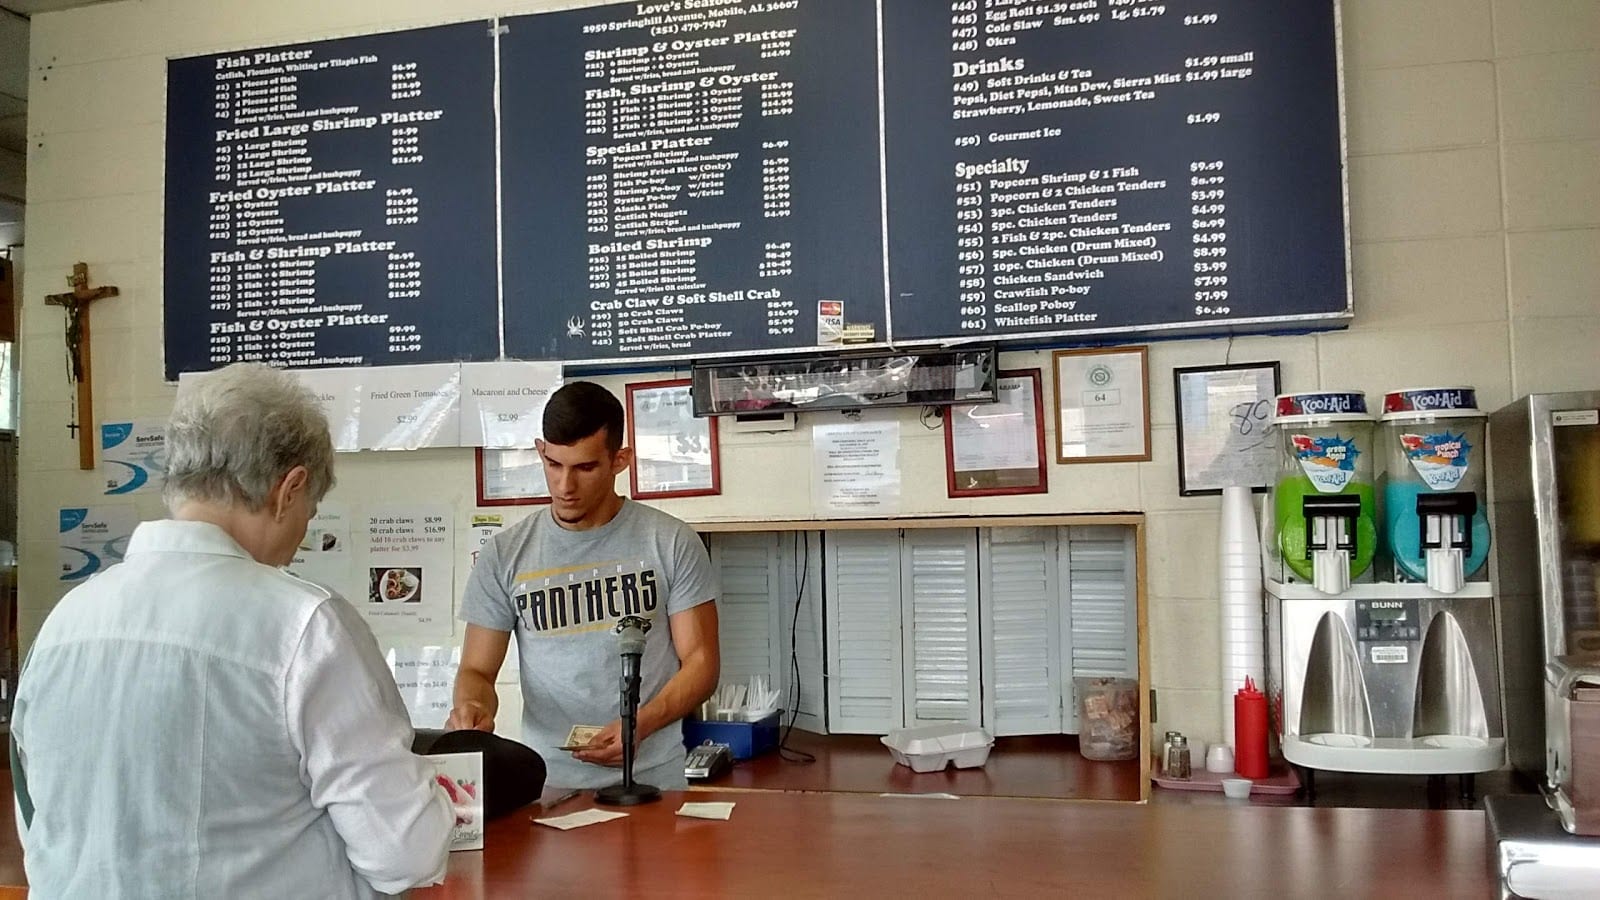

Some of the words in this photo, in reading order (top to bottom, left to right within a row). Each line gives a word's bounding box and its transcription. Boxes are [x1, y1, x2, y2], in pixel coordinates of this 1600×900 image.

[583, 23, 606, 32] 2959
[608, 16, 661, 30] Springhill
[664, 12, 705, 23] Avenue,
[708, 6, 746, 17] Mobile,
[748, 3, 764, 12] AL
[766, 0, 798, 11] 36607
[637, 0, 680, 15] Love's
[952, 13, 976, 24] #45)
[985, 10, 1006, 21] Egg
[1009, 6, 1032, 17] Roll
[1036, 3, 1067, 14] $1.39
[1069, 0, 1096, 10] each
[651, 24, 678, 36] (251)
[681, 19, 726, 31] 479-7947
[952, 26, 976, 37] #47)
[985, 22, 1010, 33] Cole
[1013, 20, 1042, 30] Slaw
[1054, 16, 1076, 25] Sm.
[1112, 9, 1129, 20] Lg.
[1132, 6, 1164, 17] $1.79
[952, 40, 977, 50] #48)
[986, 37, 1015, 46] Okra
[1184, 14, 1217, 25] $1.99
[584, 46, 648, 60] Shrimp
[652, 42, 667, 52] &
[672, 37, 729, 50] Oyster
[734, 29, 796, 43] Platter
[216, 56, 250, 68] Fish
[254, 50, 312, 64] Platter
[952, 58, 1024, 77] Drinks
[953, 80, 978, 91] #49)
[987, 77, 1011, 88] Soft
[1014, 73, 1055, 84] Drinks
[1058, 70, 1068, 79] &
[1071, 69, 1091, 78] Tea
[1185, 56, 1217, 67] $1.59
[1220, 52, 1252, 63] small
[585, 87, 625, 100] Fish,
[630, 81, 694, 94] Shrimp
[699, 76, 714, 86] &
[718, 72, 777, 85] Oyster
[954, 93, 987, 105] Pepsi,
[990, 91, 1014, 101] Diet
[1017, 86, 1051, 98] Pepsi,
[1054, 84, 1077, 94] Mtn
[1080, 82, 1110, 91] Dew,
[1113, 77, 1151, 88] Sierra
[1154, 73, 1180, 84] Mist
[1186, 70, 1218, 81] $1.99
[1220, 68, 1251, 78] large
[953, 105, 1024, 119] Strawberry,
[1027, 96, 1091, 110] Lemonade,
[1094, 92, 1130, 104] Sweet
[1133, 90, 1154, 99] Tea
[216, 127, 258, 141] Fried
[263, 124, 308, 136] Large
[313, 117, 377, 130] Shrimp
[381, 110, 442, 124] Platter
[955, 135, 980, 146] #50)
[988, 129, 1040, 142] Gourmet
[1044, 128, 1060, 136] Ice
[1187, 112, 1219, 123] $1.99
[586, 141, 646, 157] Special
[651, 137, 712, 149] Platter
[955, 158, 1028, 179] Specialty
[956, 181, 981, 192] #51)
[990, 178, 1038, 189] Popcorn
[1041, 173, 1086, 183] Shrimp
[1089, 170, 1099, 179] &
[1103, 170, 1108, 178] 1
[1112, 167, 1138, 177] Fish
[210, 189, 252, 202] Fried
[256, 186, 311, 199] Oyster
[316, 180, 375, 193] Platter
[211, 251, 244, 262] Fish
[249, 249, 263, 259] &
[267, 246, 330, 258] Shrimp
[335, 241, 395, 253] Platter
[588, 240, 641, 254] Boiled
[646, 237, 711, 249] Shrimp
[590, 300, 622, 310] Crab
[625, 298, 658, 307] Claw
[662, 295, 673, 305] &
[677, 293, 705, 304] Soft
[708, 290, 743, 302] Shell
[747, 288, 780, 299] Crab
[211, 322, 244, 333] Fish
[249, 320, 263, 330] &
[267, 318, 323, 330] Oyster
[327, 314, 388, 326] Platter
[961, 318, 985, 329] #61)
[994, 315, 1051, 326] Whitefish
[1055, 313, 1097, 322] Platter
[1195, 305, 1229, 315] $6.49
[498, 413, 518, 421] $2.99
[515, 570, 657, 631] PANTHERS
